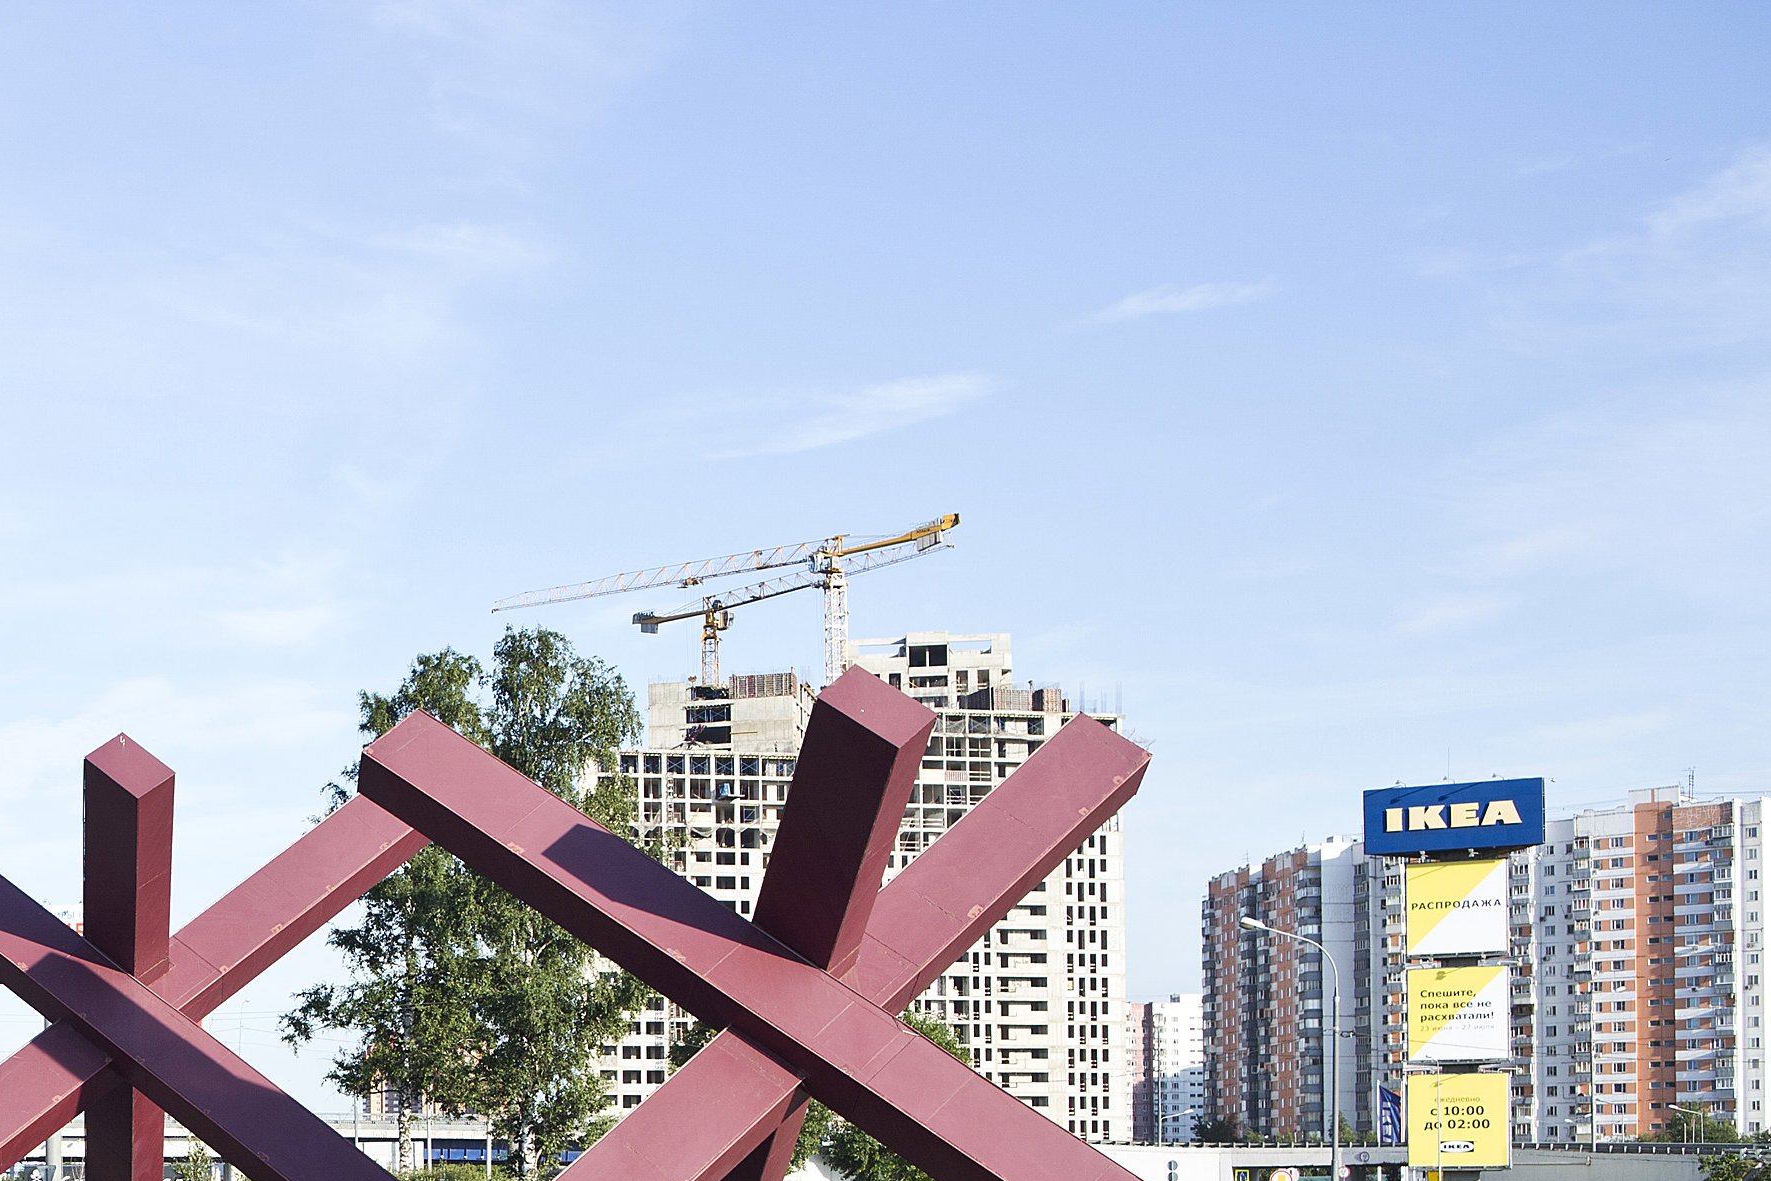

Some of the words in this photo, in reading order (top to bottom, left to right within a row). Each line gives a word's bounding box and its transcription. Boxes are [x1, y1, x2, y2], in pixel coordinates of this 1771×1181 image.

[1385, 800, 1523, 832] IKEA
[1411, 899, 1501, 910] РАСПРОДАЖА
[1420, 989, 1476, 998] Спешите,
[1420, 1002, 1449, 1010] пока
[1453, 1001, 1474, 1009] все
[1420, 1011, 1494, 1023] расхватали!
[1444, 1105, 1484, 1116] 10:00
[1424, 1121, 1442, 1131] до
[1448, 1119, 1490, 1129] 02:00
